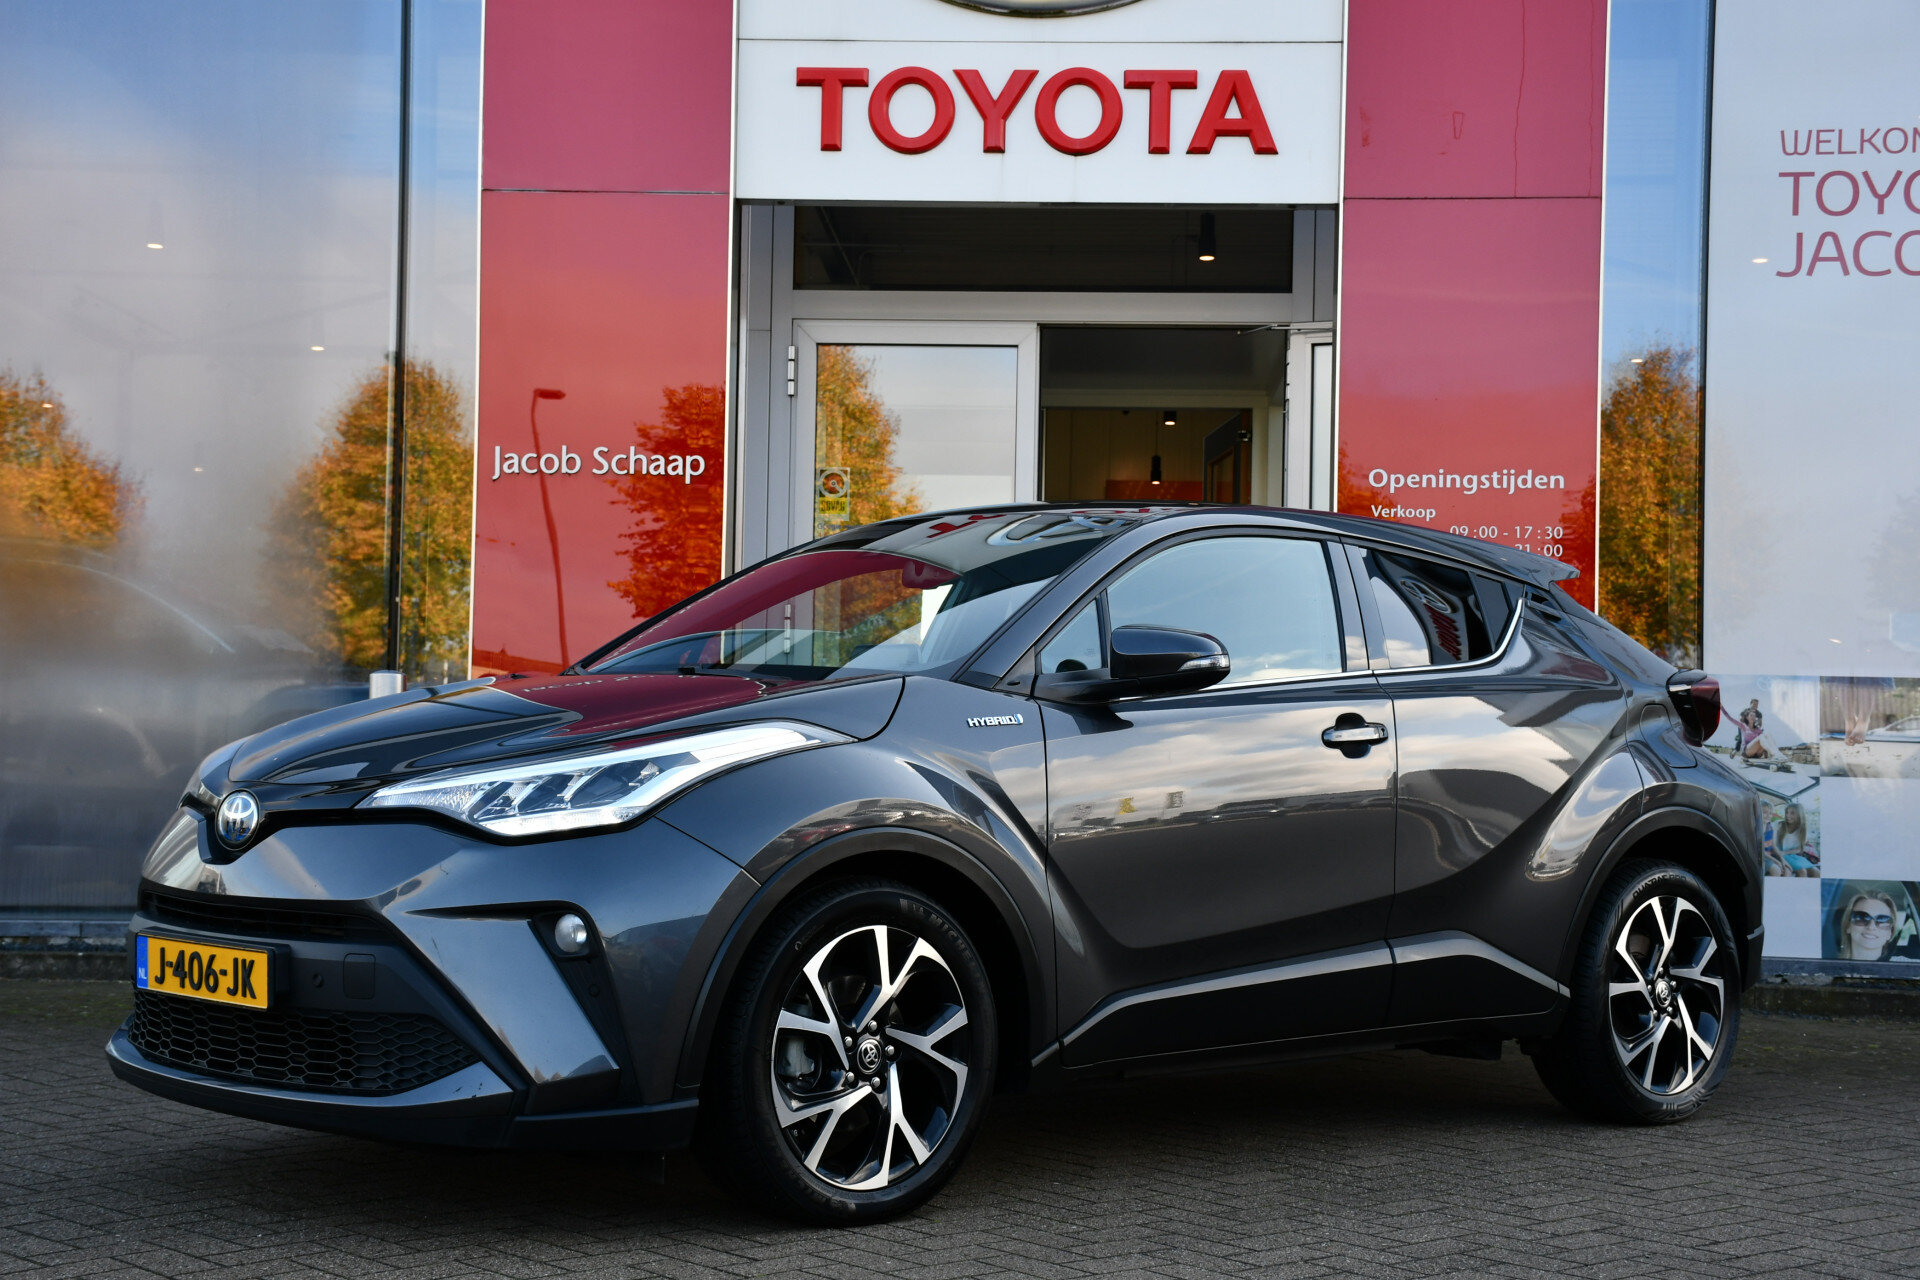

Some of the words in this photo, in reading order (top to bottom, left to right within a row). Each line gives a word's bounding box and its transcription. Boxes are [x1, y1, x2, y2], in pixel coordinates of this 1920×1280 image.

[796, 66, 1279, 156] TOYOTA
[492, 445, 582, 481] Jacob
[592, 446, 706, 485] Schaap
[1368, 468, 1566, 495] Openingstijden
[1371, 505, 1436, 521] Verkoop
[1514, 526, 1564, 540] 17:30
[967, 715, 1018, 727] HYBRID
[138, 967, 147, 980] NL
[154, 946, 257, 1000] J-406-JK
